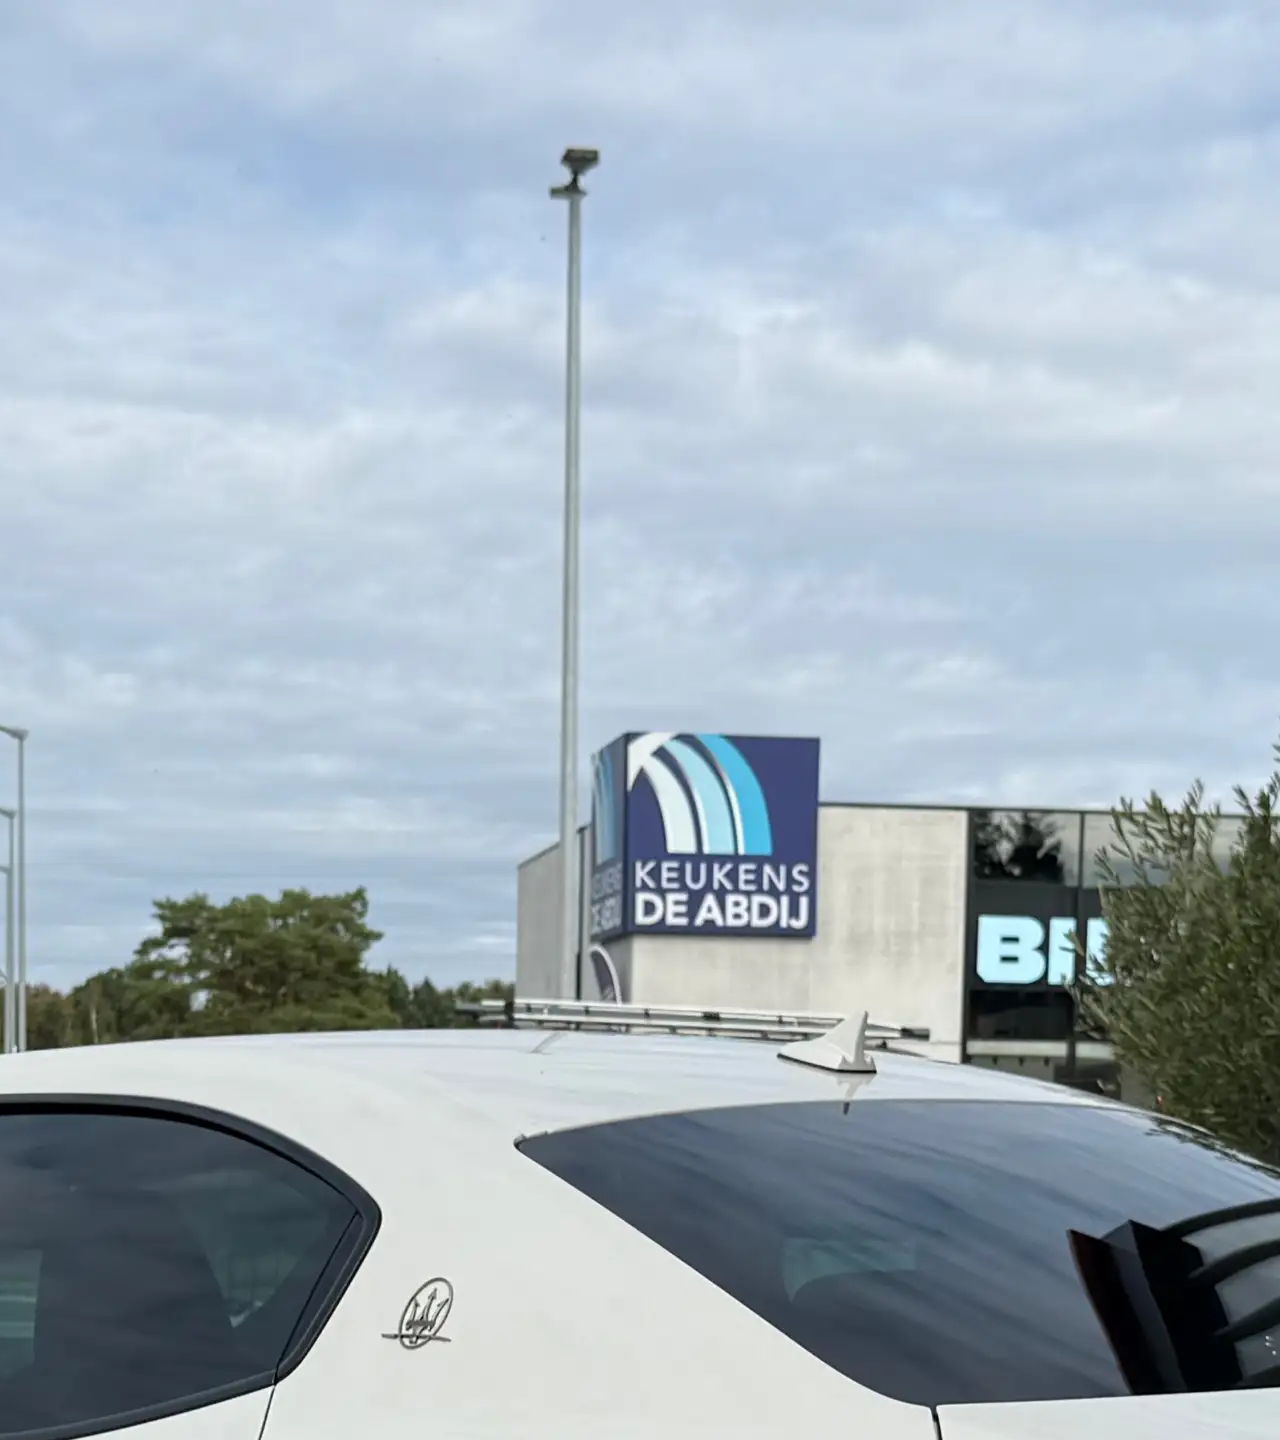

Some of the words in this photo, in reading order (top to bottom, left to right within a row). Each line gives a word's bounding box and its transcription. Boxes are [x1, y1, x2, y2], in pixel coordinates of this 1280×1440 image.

[634, 860, 810, 893] KEUKENS
[634, 891, 689, 926] DE
[694, 892, 809, 930] ABDIJ
